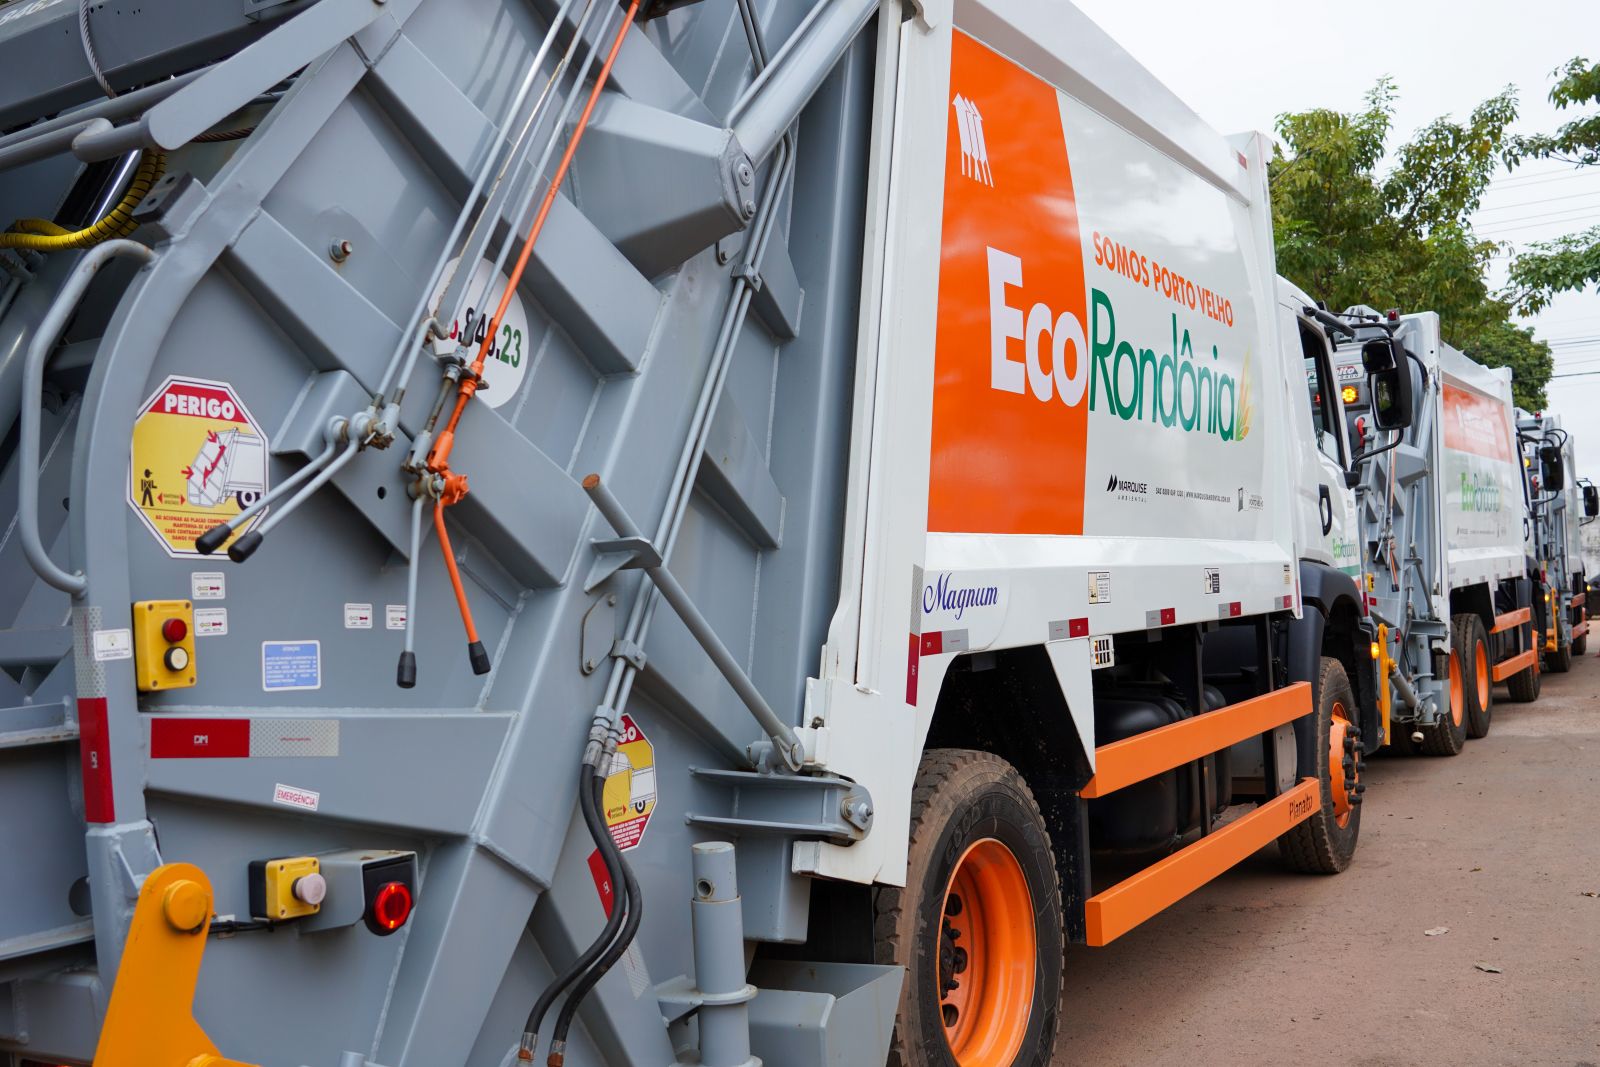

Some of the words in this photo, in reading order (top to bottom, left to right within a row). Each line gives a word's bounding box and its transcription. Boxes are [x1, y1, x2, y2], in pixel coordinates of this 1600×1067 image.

[1093, 231, 1150, 288] SOMOS
[1152, 260, 1196, 311] PORTO
[1196, 282, 1234, 328] VELHO
[164, 392, 236, 420] PERIGO
[1117, 495, 1147, 503] AMBIENTAL
[1118, 480, 1148, 494] MARQUISE
[922, 572, 999, 620] Magnum
[1289, 793, 1313, 821] Planalto
